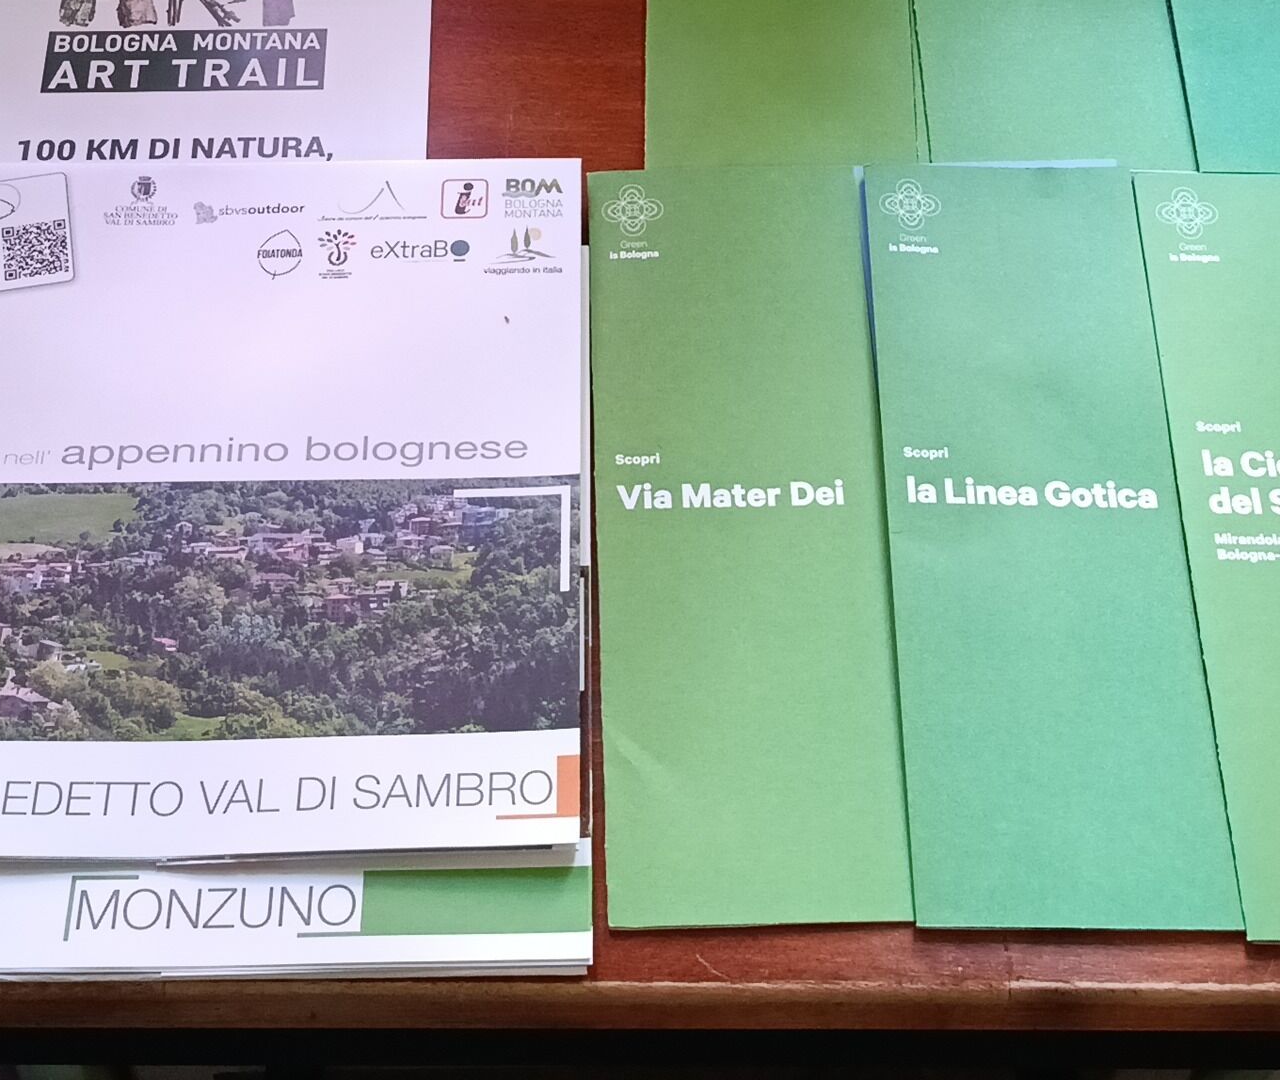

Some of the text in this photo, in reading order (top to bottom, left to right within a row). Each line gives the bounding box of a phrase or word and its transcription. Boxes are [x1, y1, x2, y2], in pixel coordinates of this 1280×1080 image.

[53, 32, 321, 53] BOLOGNA MONTANA
[47, 57, 320, 90] ART TRAIL
[17, 136, 334, 162] 100 KM DI NATURA,
[505, 178, 564, 196] BOM
[218, 202, 306, 216] sbvsoutdoor
[504, 199, 564, 208] BOLOGNA
[504, 208, 564, 218] MONTANA
[619, 250, 660, 260] Bologna
[620, 240, 648, 249] Green
[1195, 420, 1241, 434] Scopri
[3, 449, 52, 466] nell'
[61, 437, 289, 470] appennino
[305, 435, 529, 467] bolognese
[615, 453, 661, 467] Scopri
[903, 446, 949, 460] Scopri
[1201, 449, 1234, 477] la
[616, 479, 845, 510] Via Mater Dei
[906, 475, 1159, 509] la Linea Gotica
[1208, 486, 1263, 515] del
[199, 778, 281, 815] VAL
[295, 776, 337, 812] DI
[352, 770, 554, 810] SAMBRO
[73, 883, 357, 933] MONZUNO
